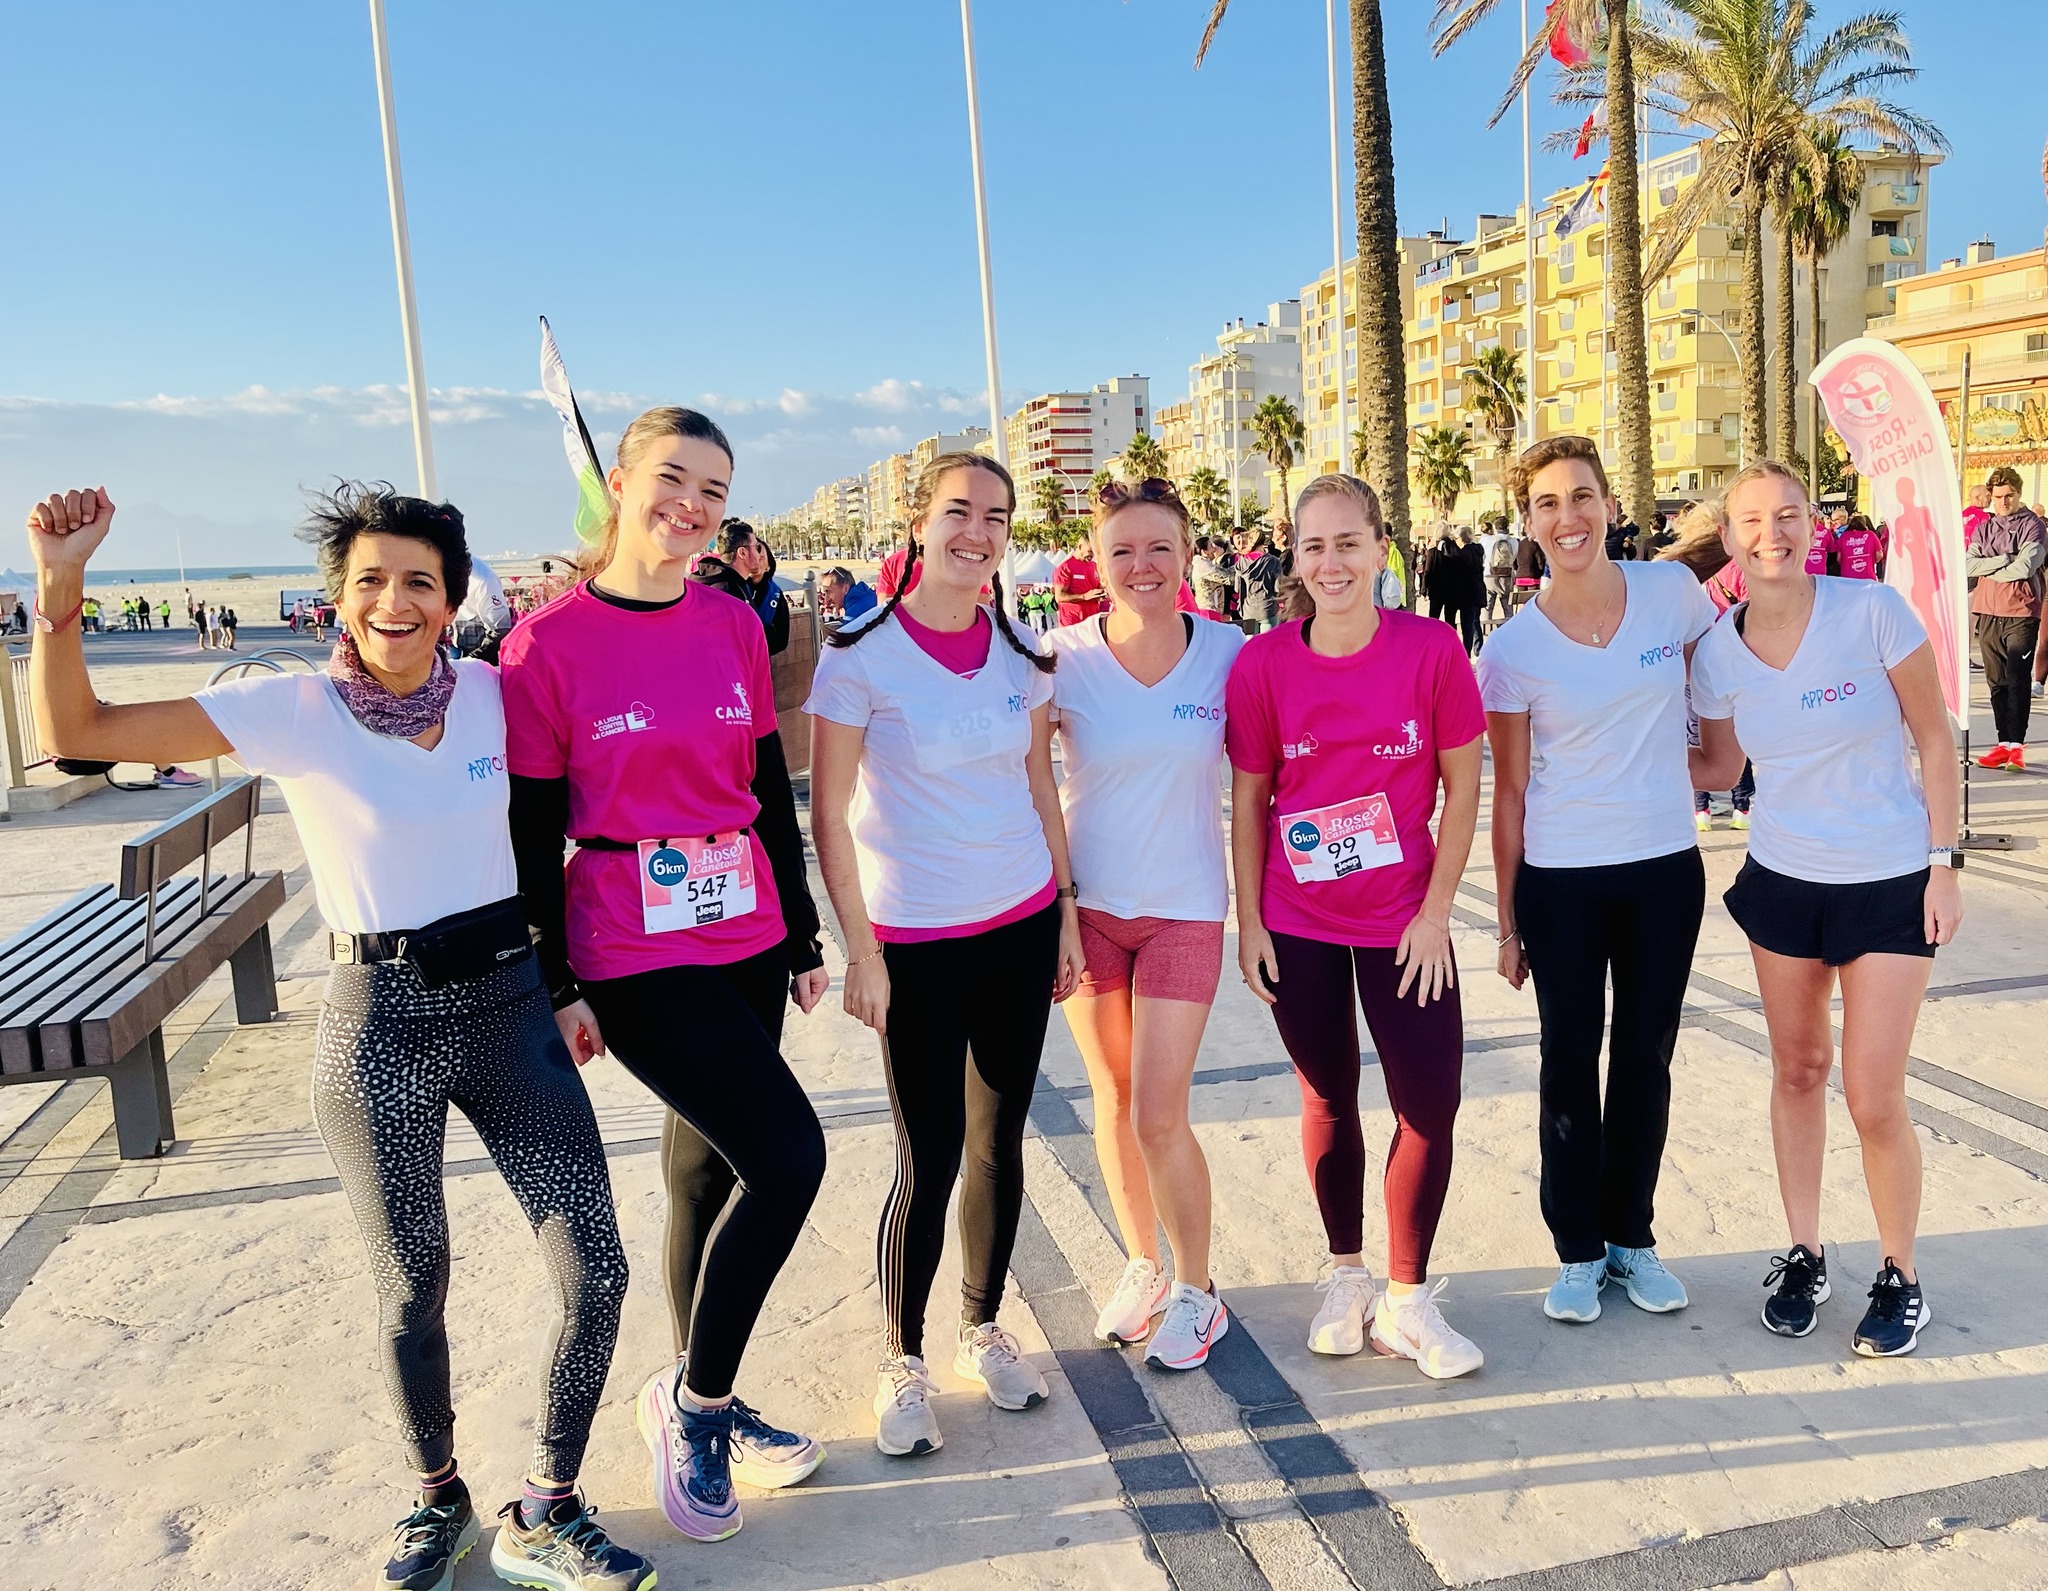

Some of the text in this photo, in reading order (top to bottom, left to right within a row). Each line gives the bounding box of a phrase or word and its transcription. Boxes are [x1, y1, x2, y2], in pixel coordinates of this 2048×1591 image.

[1640, 640, 1682, 669] APPOLO
[1801, 682, 1857, 710] APPOLO
[593, 714, 624, 727] LA LIGUE
[1173, 704, 1220, 721] APPOLO
[591, 732, 601, 740] LE
[600, 726, 627, 738] CANCER
[598, 720, 625, 732] CONTRE
[1330, 811, 1371, 833] Rose
[1291, 830, 1319, 845] 6km
[702, 846, 738, 865] Rose
[1327, 836, 1357, 860] 99
[653, 858, 686, 876] 6km
[1336, 857, 1359, 872] Jeep
[687, 873, 728, 903] 547
[696, 904, 722, 917] Jeep
[668, 1421, 688, 1474] HOKA
